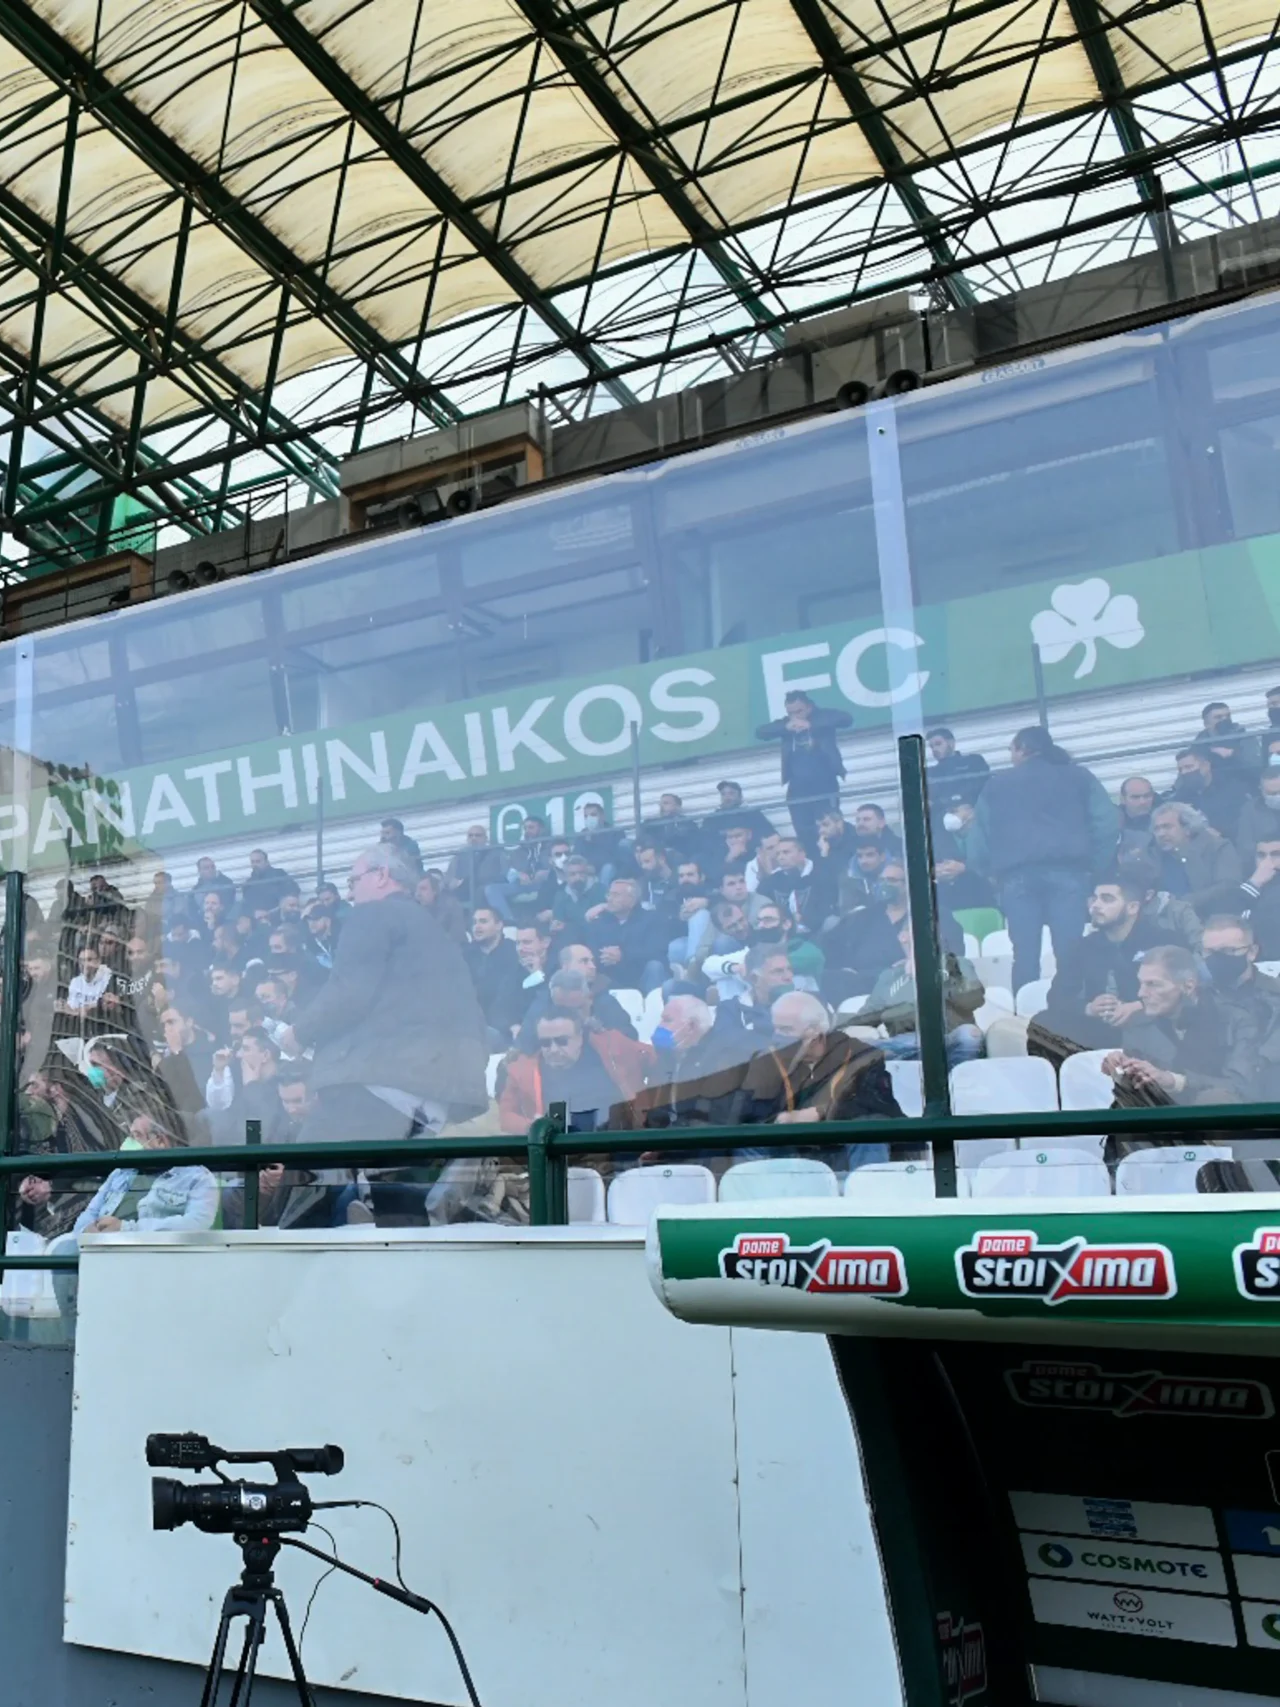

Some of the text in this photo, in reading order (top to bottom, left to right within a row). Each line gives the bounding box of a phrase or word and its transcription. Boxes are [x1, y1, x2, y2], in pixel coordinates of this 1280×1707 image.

[760, 626, 931, 724] FC
[741, 1240, 780, 1255] pame
[981, 1238, 1026, 1253] pame
[1080, 1551, 1209, 1579] COSMOTE
